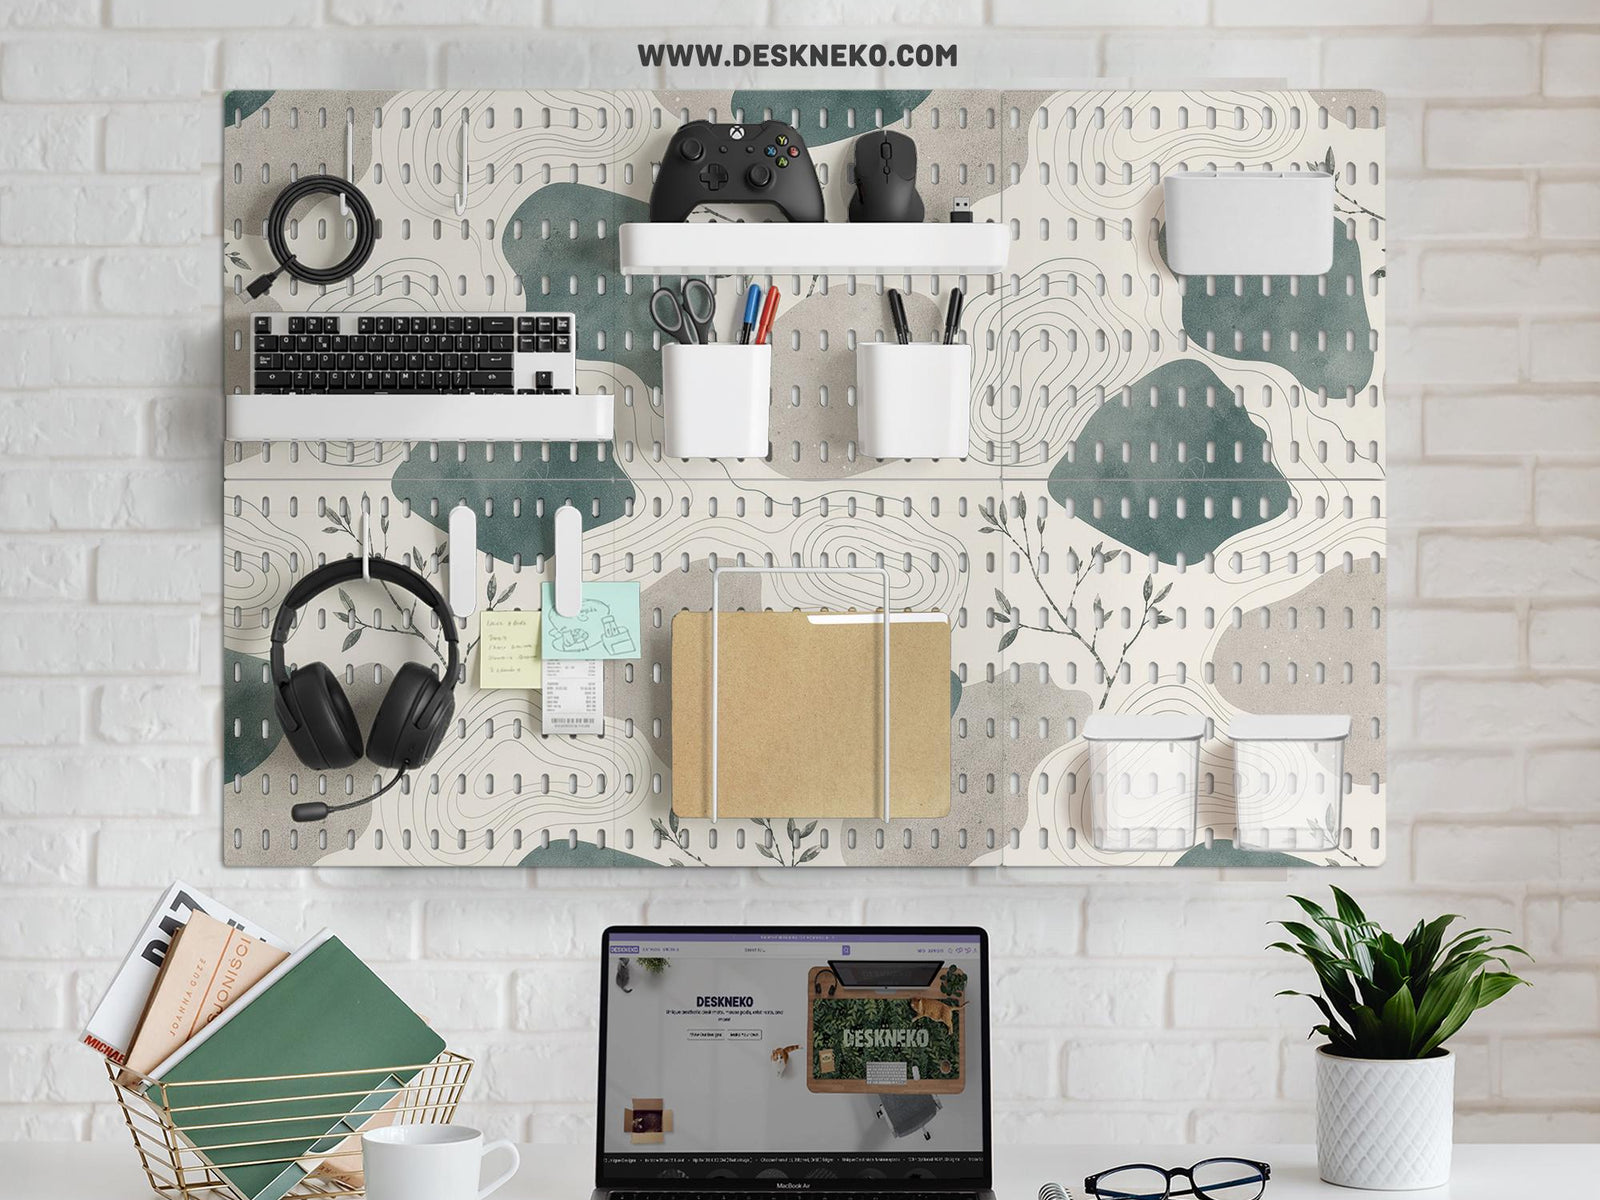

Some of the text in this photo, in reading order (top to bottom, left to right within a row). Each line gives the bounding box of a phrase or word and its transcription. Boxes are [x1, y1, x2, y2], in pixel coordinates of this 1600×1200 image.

[778, 136, 786, 145] Y
[169, 957, 207, 1036] JOANNA GUZE
[696, 996, 754, 1007] DESKNEKO
[843, 1029, 929, 1047] DESKNEKO
